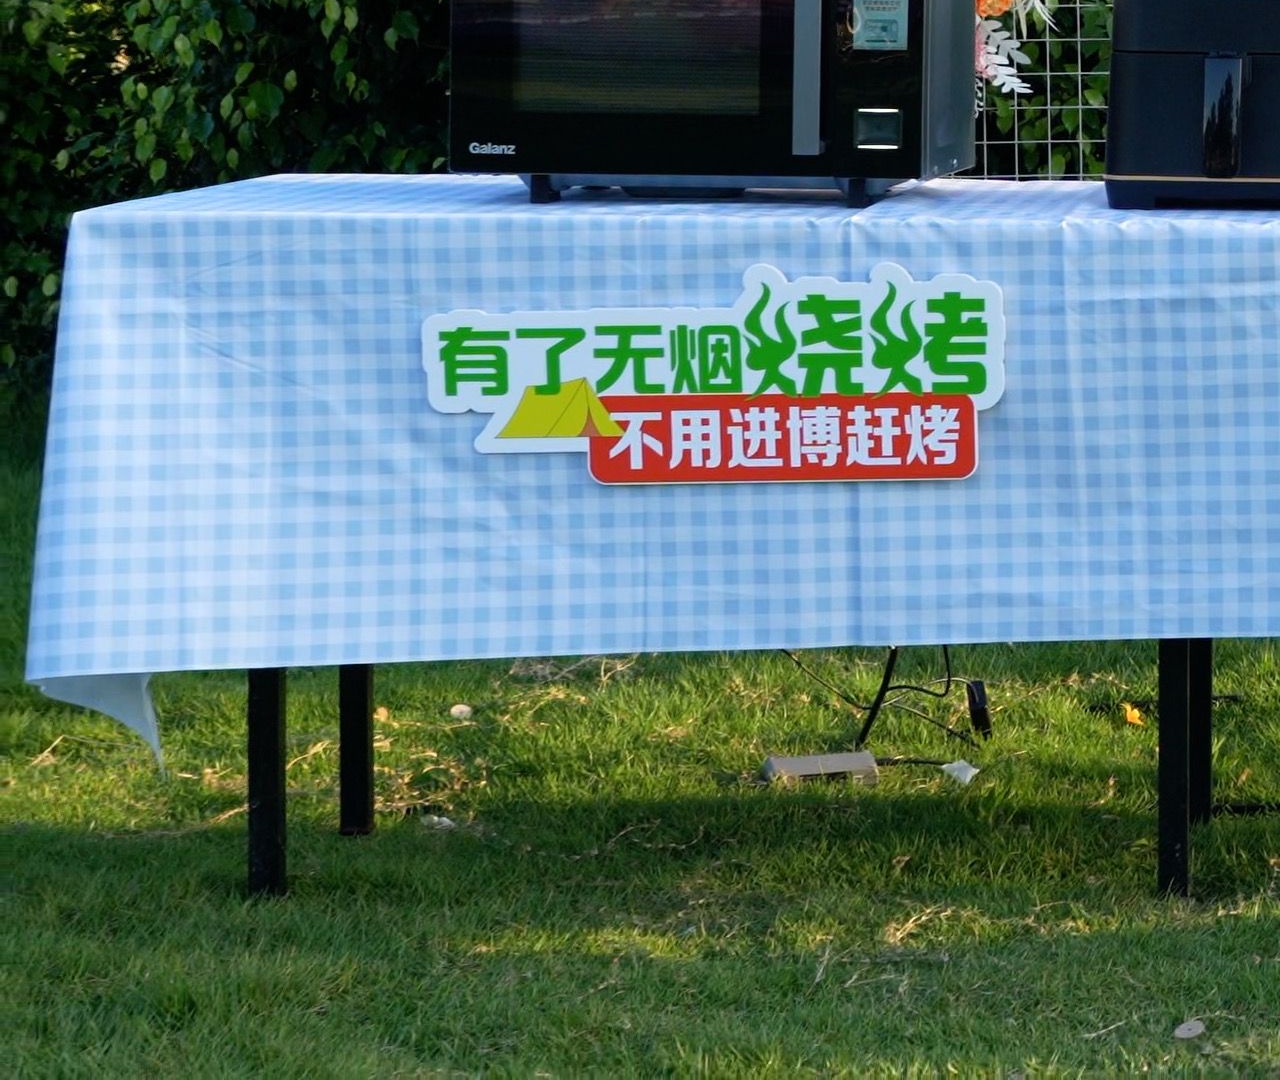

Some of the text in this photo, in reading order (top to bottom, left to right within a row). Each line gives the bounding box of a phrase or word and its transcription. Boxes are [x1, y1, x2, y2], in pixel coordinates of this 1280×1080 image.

[468, 141, 516, 155] Galanz
[438, 281, 989, 400] 有了无烟烧烤
[608, 404, 960, 470] 不用进博赶烤
